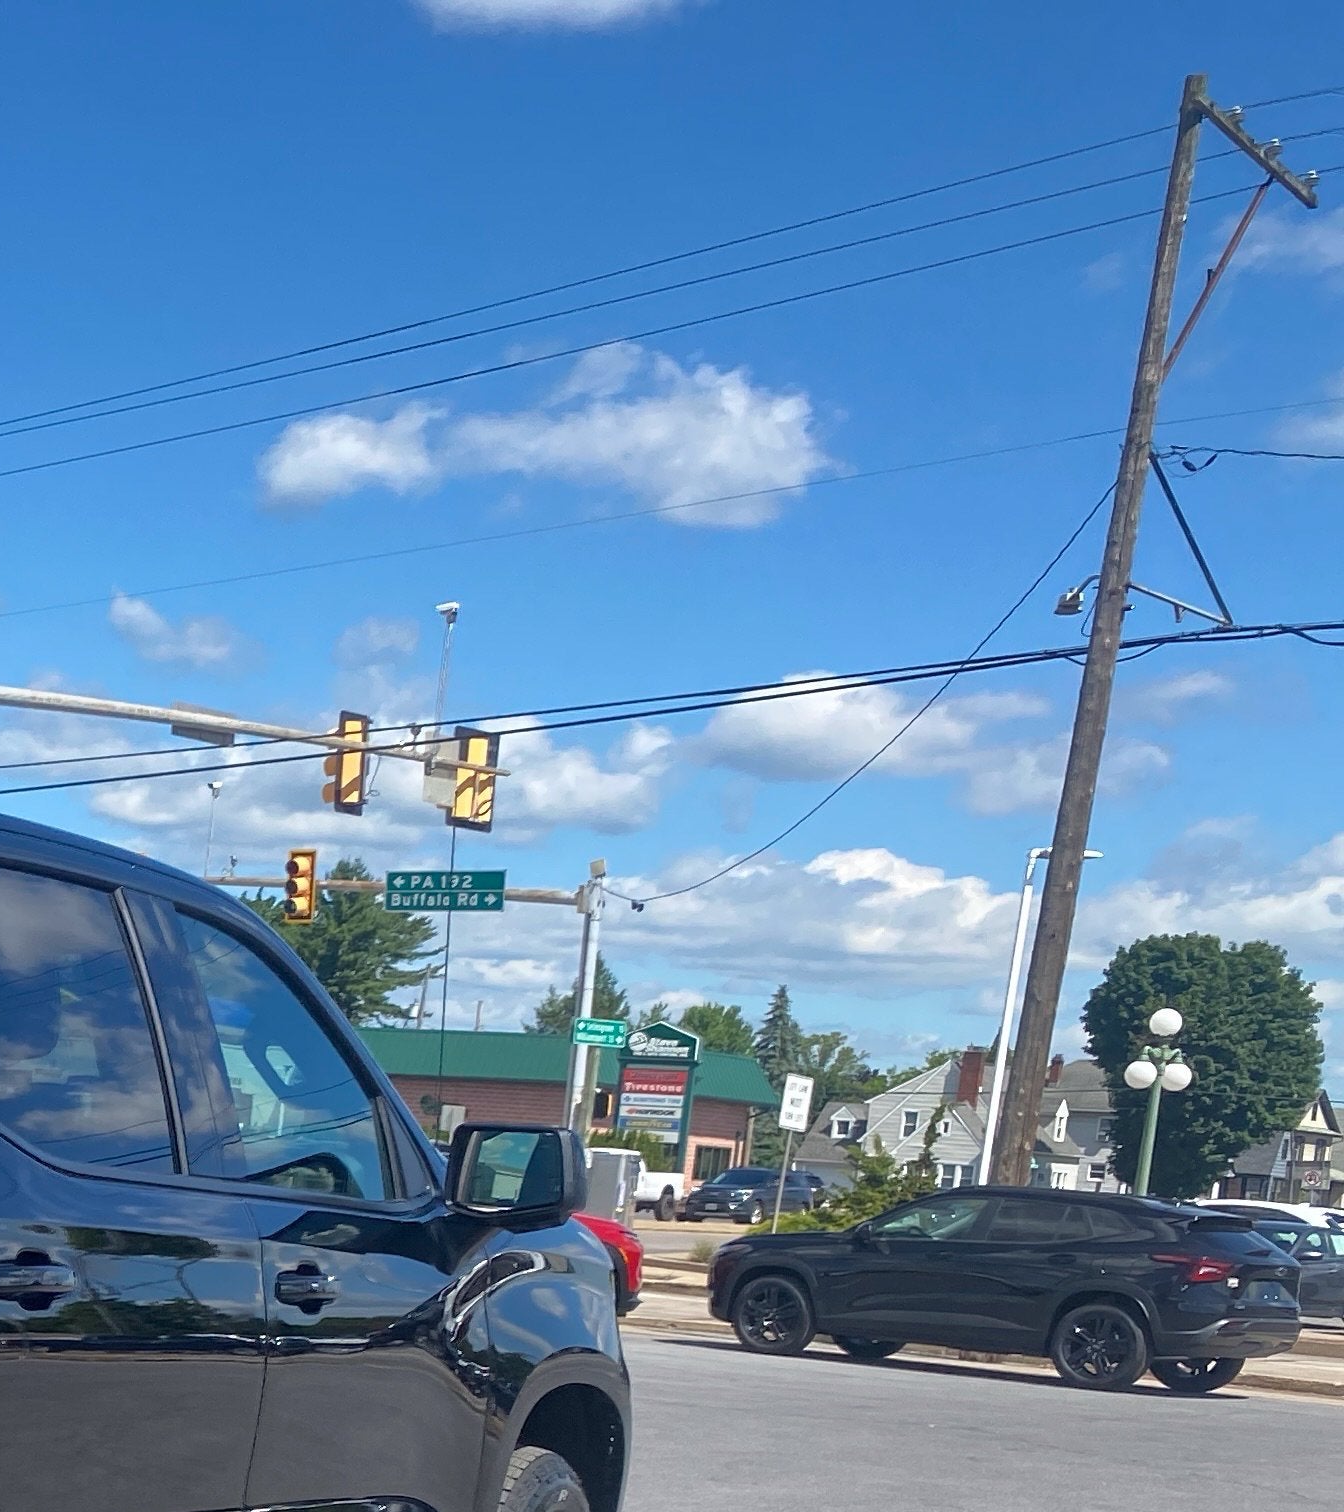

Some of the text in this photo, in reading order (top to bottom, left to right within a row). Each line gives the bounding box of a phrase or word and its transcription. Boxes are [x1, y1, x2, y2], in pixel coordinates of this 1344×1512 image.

[410, 875, 473, 889] PA 192
[390, 893, 478, 907] Buffalo Rd
